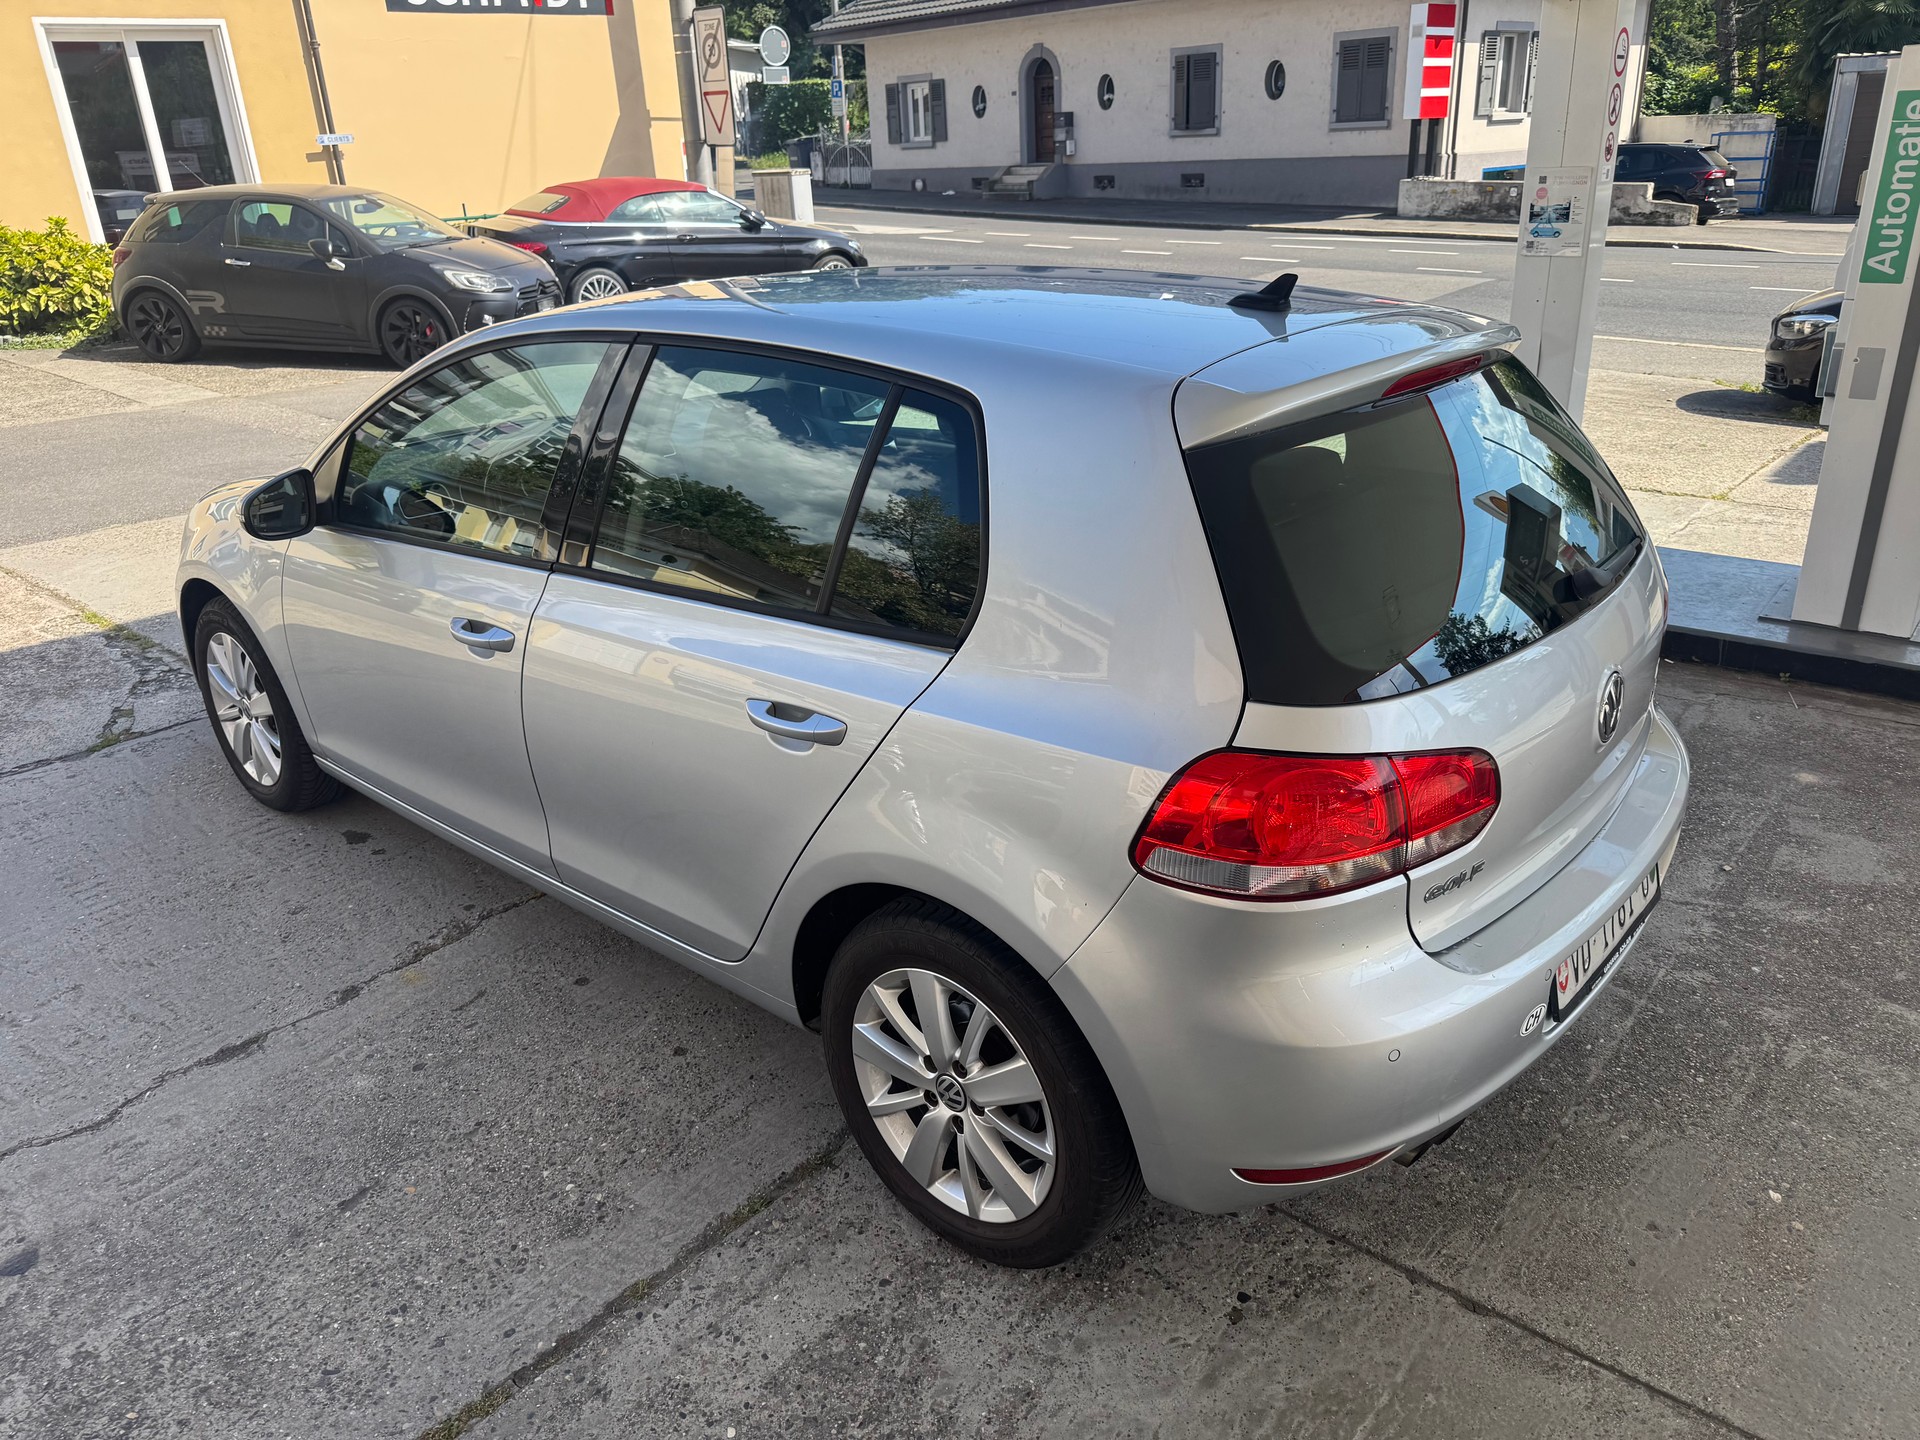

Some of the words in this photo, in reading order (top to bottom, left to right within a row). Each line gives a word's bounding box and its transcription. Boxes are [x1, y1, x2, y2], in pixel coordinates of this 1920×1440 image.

[704, 23, 715, 31] ZONE
[1424, 859, 1485, 904] GOLF
[1525, 1007, 1543, 1032] CH
